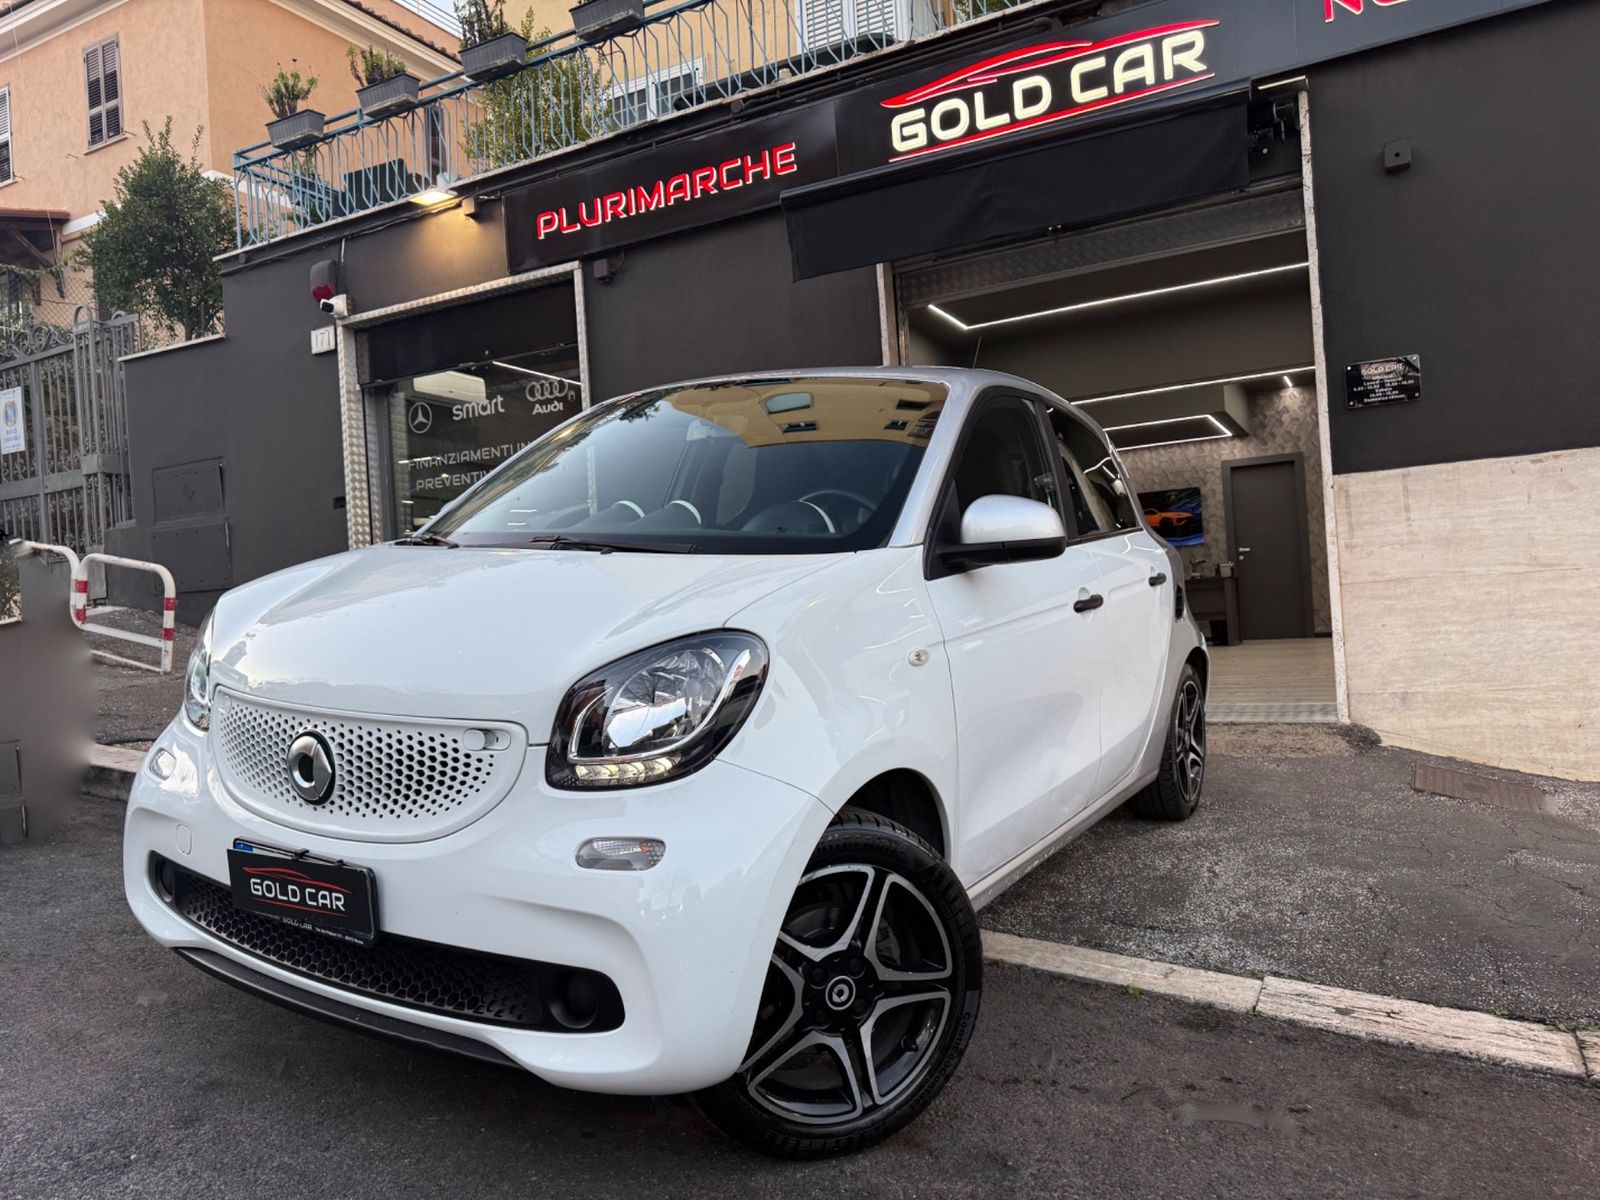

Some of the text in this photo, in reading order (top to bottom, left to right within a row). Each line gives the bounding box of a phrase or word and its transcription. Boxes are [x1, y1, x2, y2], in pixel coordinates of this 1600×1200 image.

[890, 29, 1208, 153] GOLD CAR
[536, 142, 797, 240] PLURIMARCHE
[452, 394, 505, 421] smart
[532, 400, 564, 415] Audi
[408, 443, 514, 471] FINANZIAMENTI
[250, 878, 346, 911] GOLD CAR
